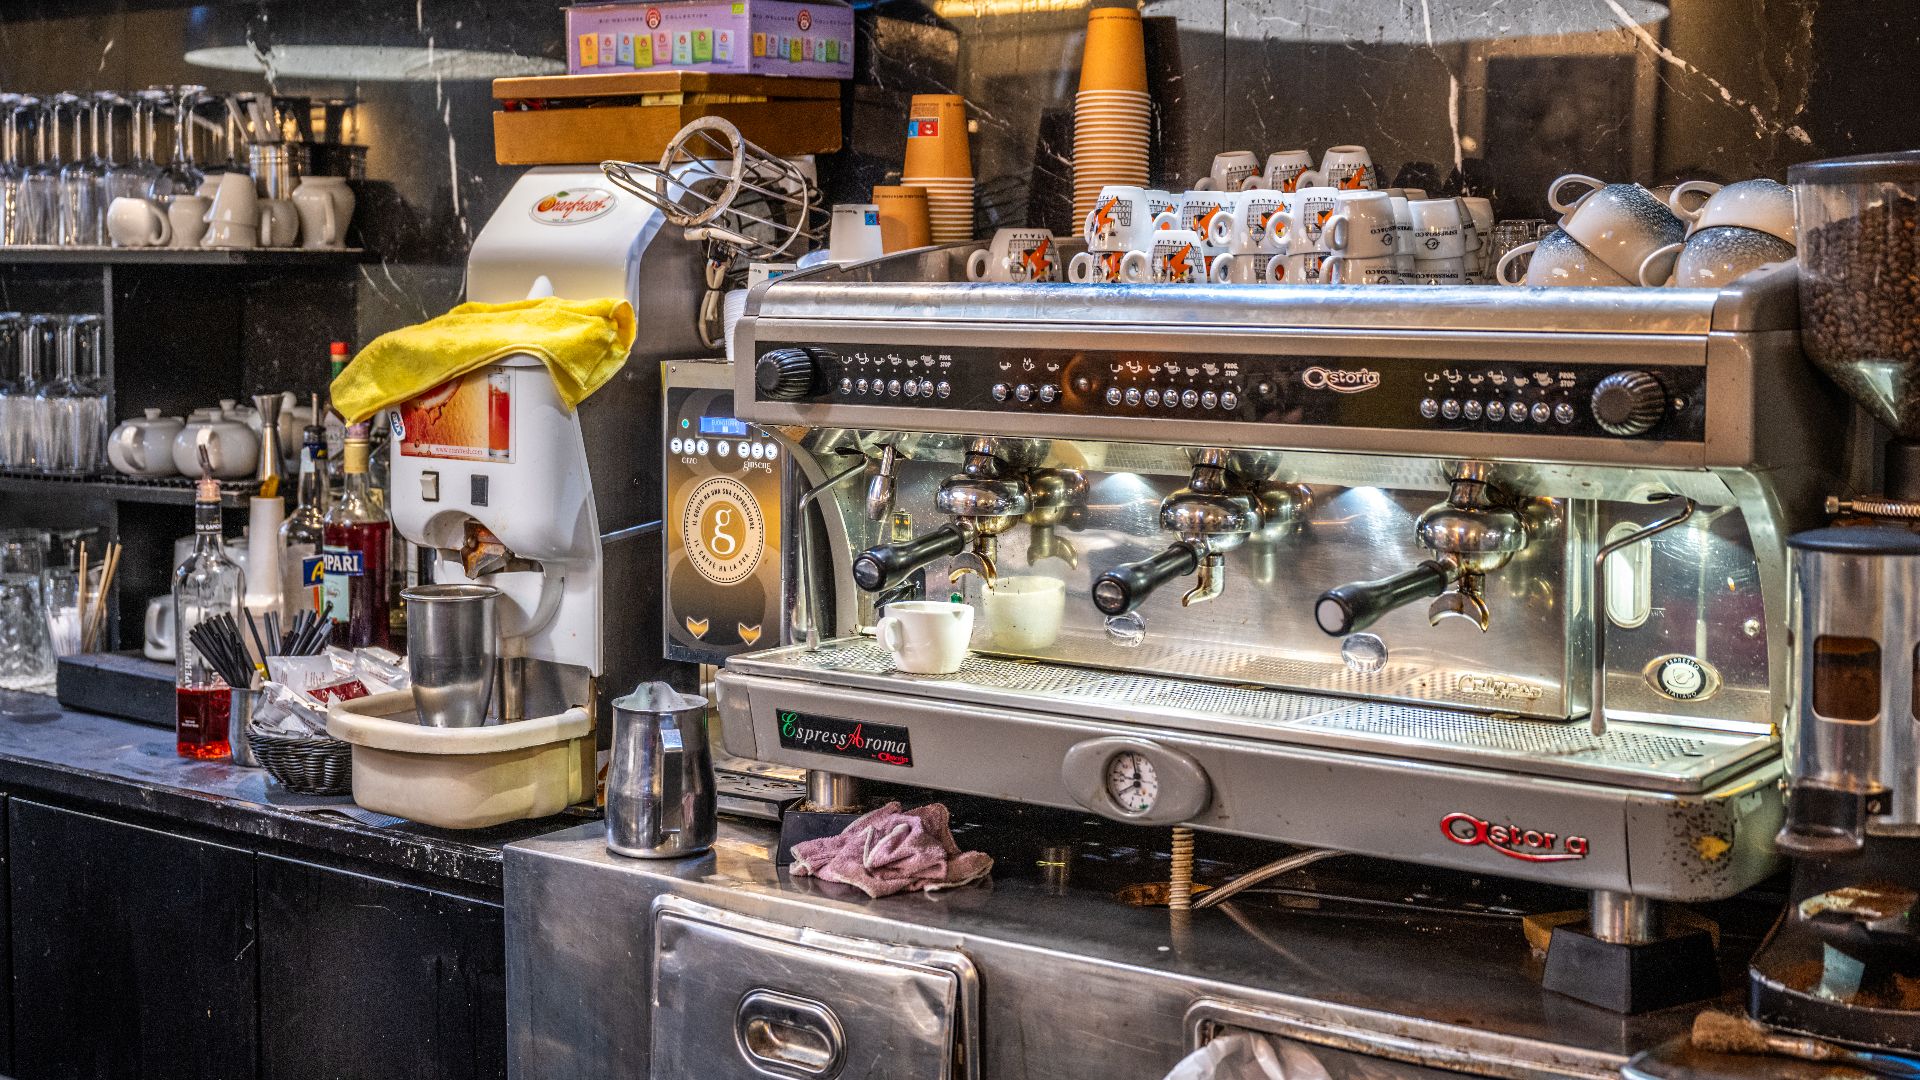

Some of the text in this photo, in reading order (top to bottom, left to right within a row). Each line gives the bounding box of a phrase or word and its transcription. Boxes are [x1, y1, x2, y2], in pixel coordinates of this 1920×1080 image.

[1560, 379, 1576, 387] STOP
[732, 493, 755, 530] ESPRESSIONE
[1665, 688, 1697, 699] ITALIANO
